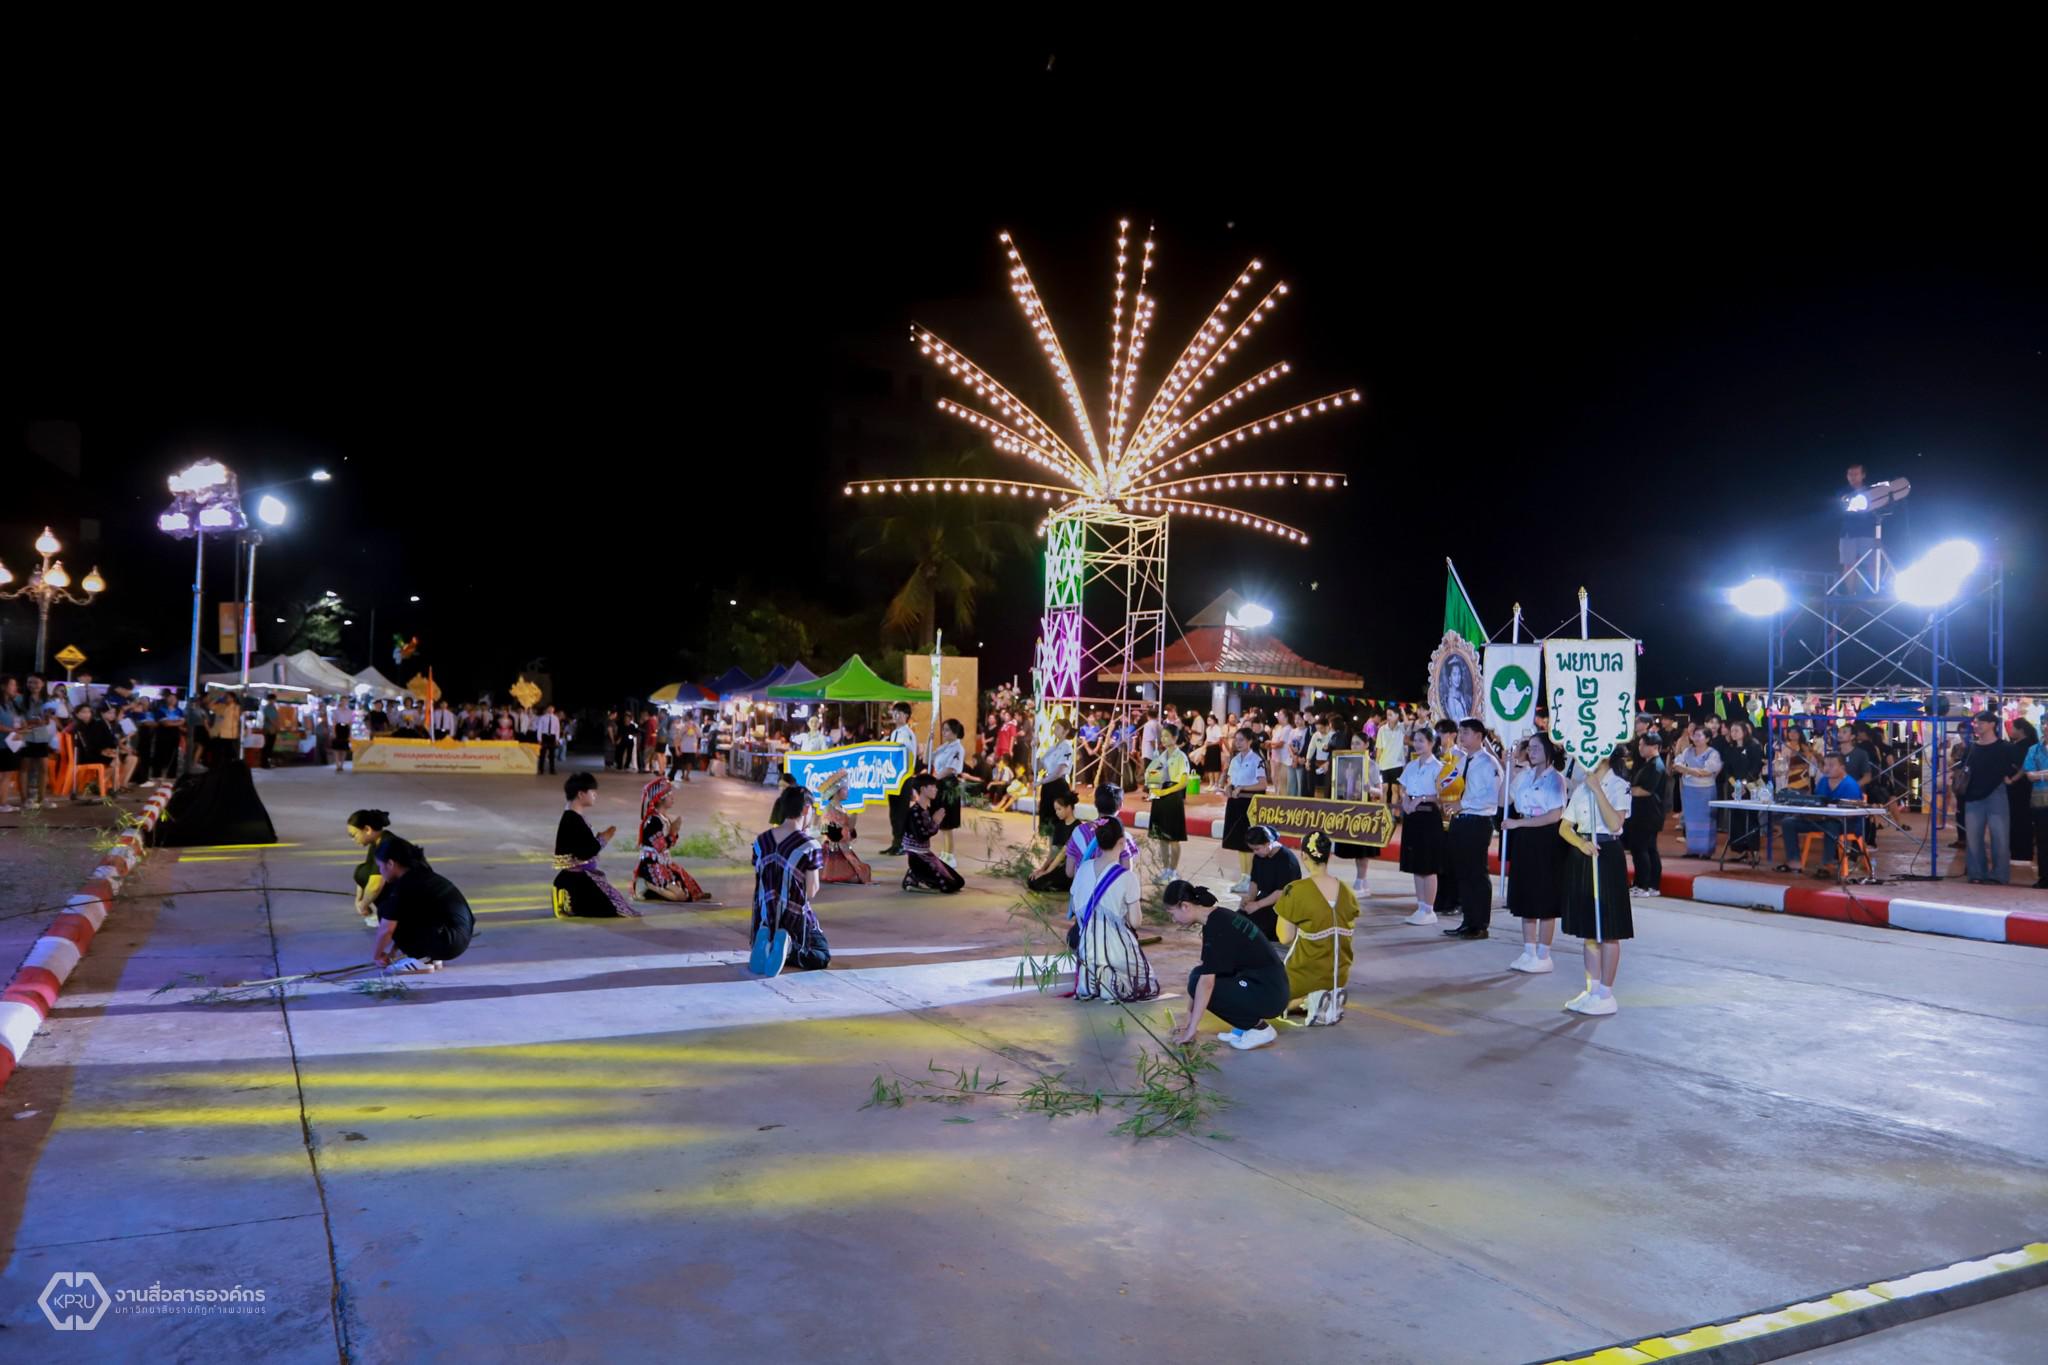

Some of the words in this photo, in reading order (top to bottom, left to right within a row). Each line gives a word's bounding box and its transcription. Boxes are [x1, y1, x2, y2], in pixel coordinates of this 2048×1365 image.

[1555, 652, 1624, 673] พยาบาล
[1258, 806, 1381, 838] คณะพยาบาลศาสตร์
